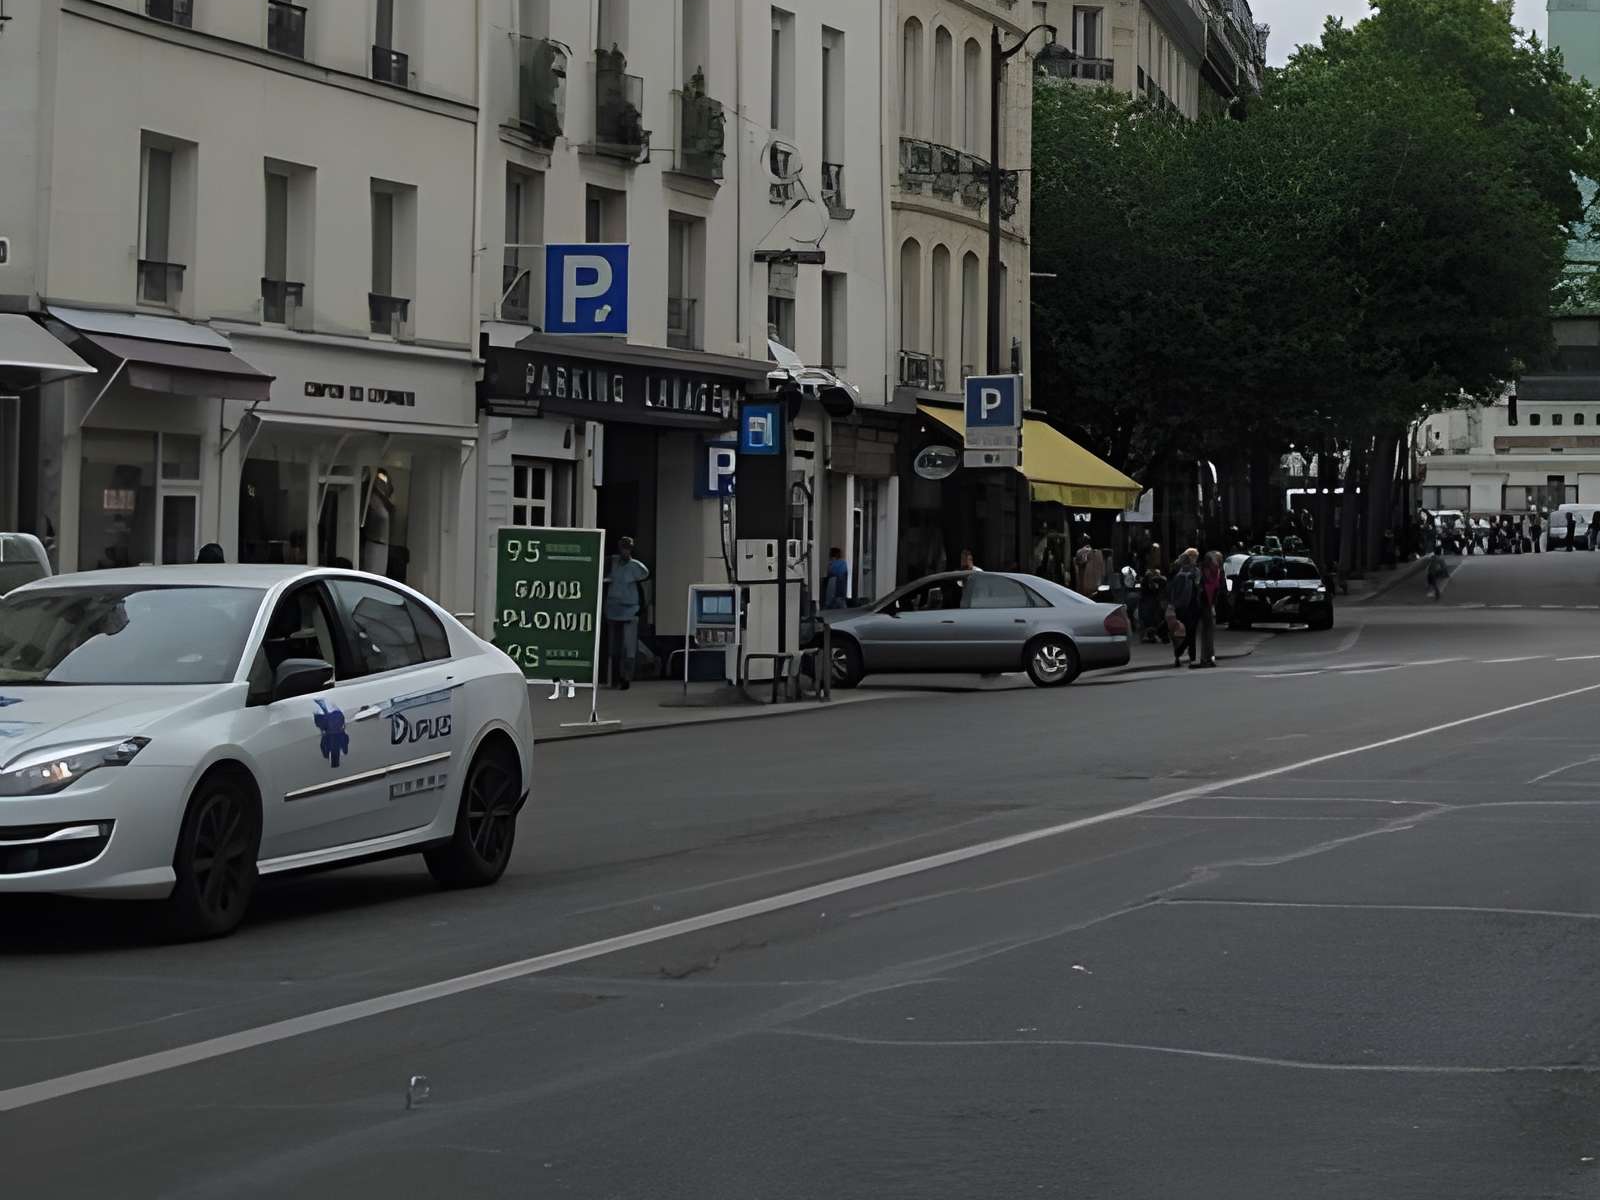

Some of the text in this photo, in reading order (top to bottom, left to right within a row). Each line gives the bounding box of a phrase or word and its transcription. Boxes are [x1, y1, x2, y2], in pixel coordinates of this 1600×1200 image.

[562, 254, 613, 323] P
[980, 387, 1002, 420] P
[708, 446, 736, 492] P
